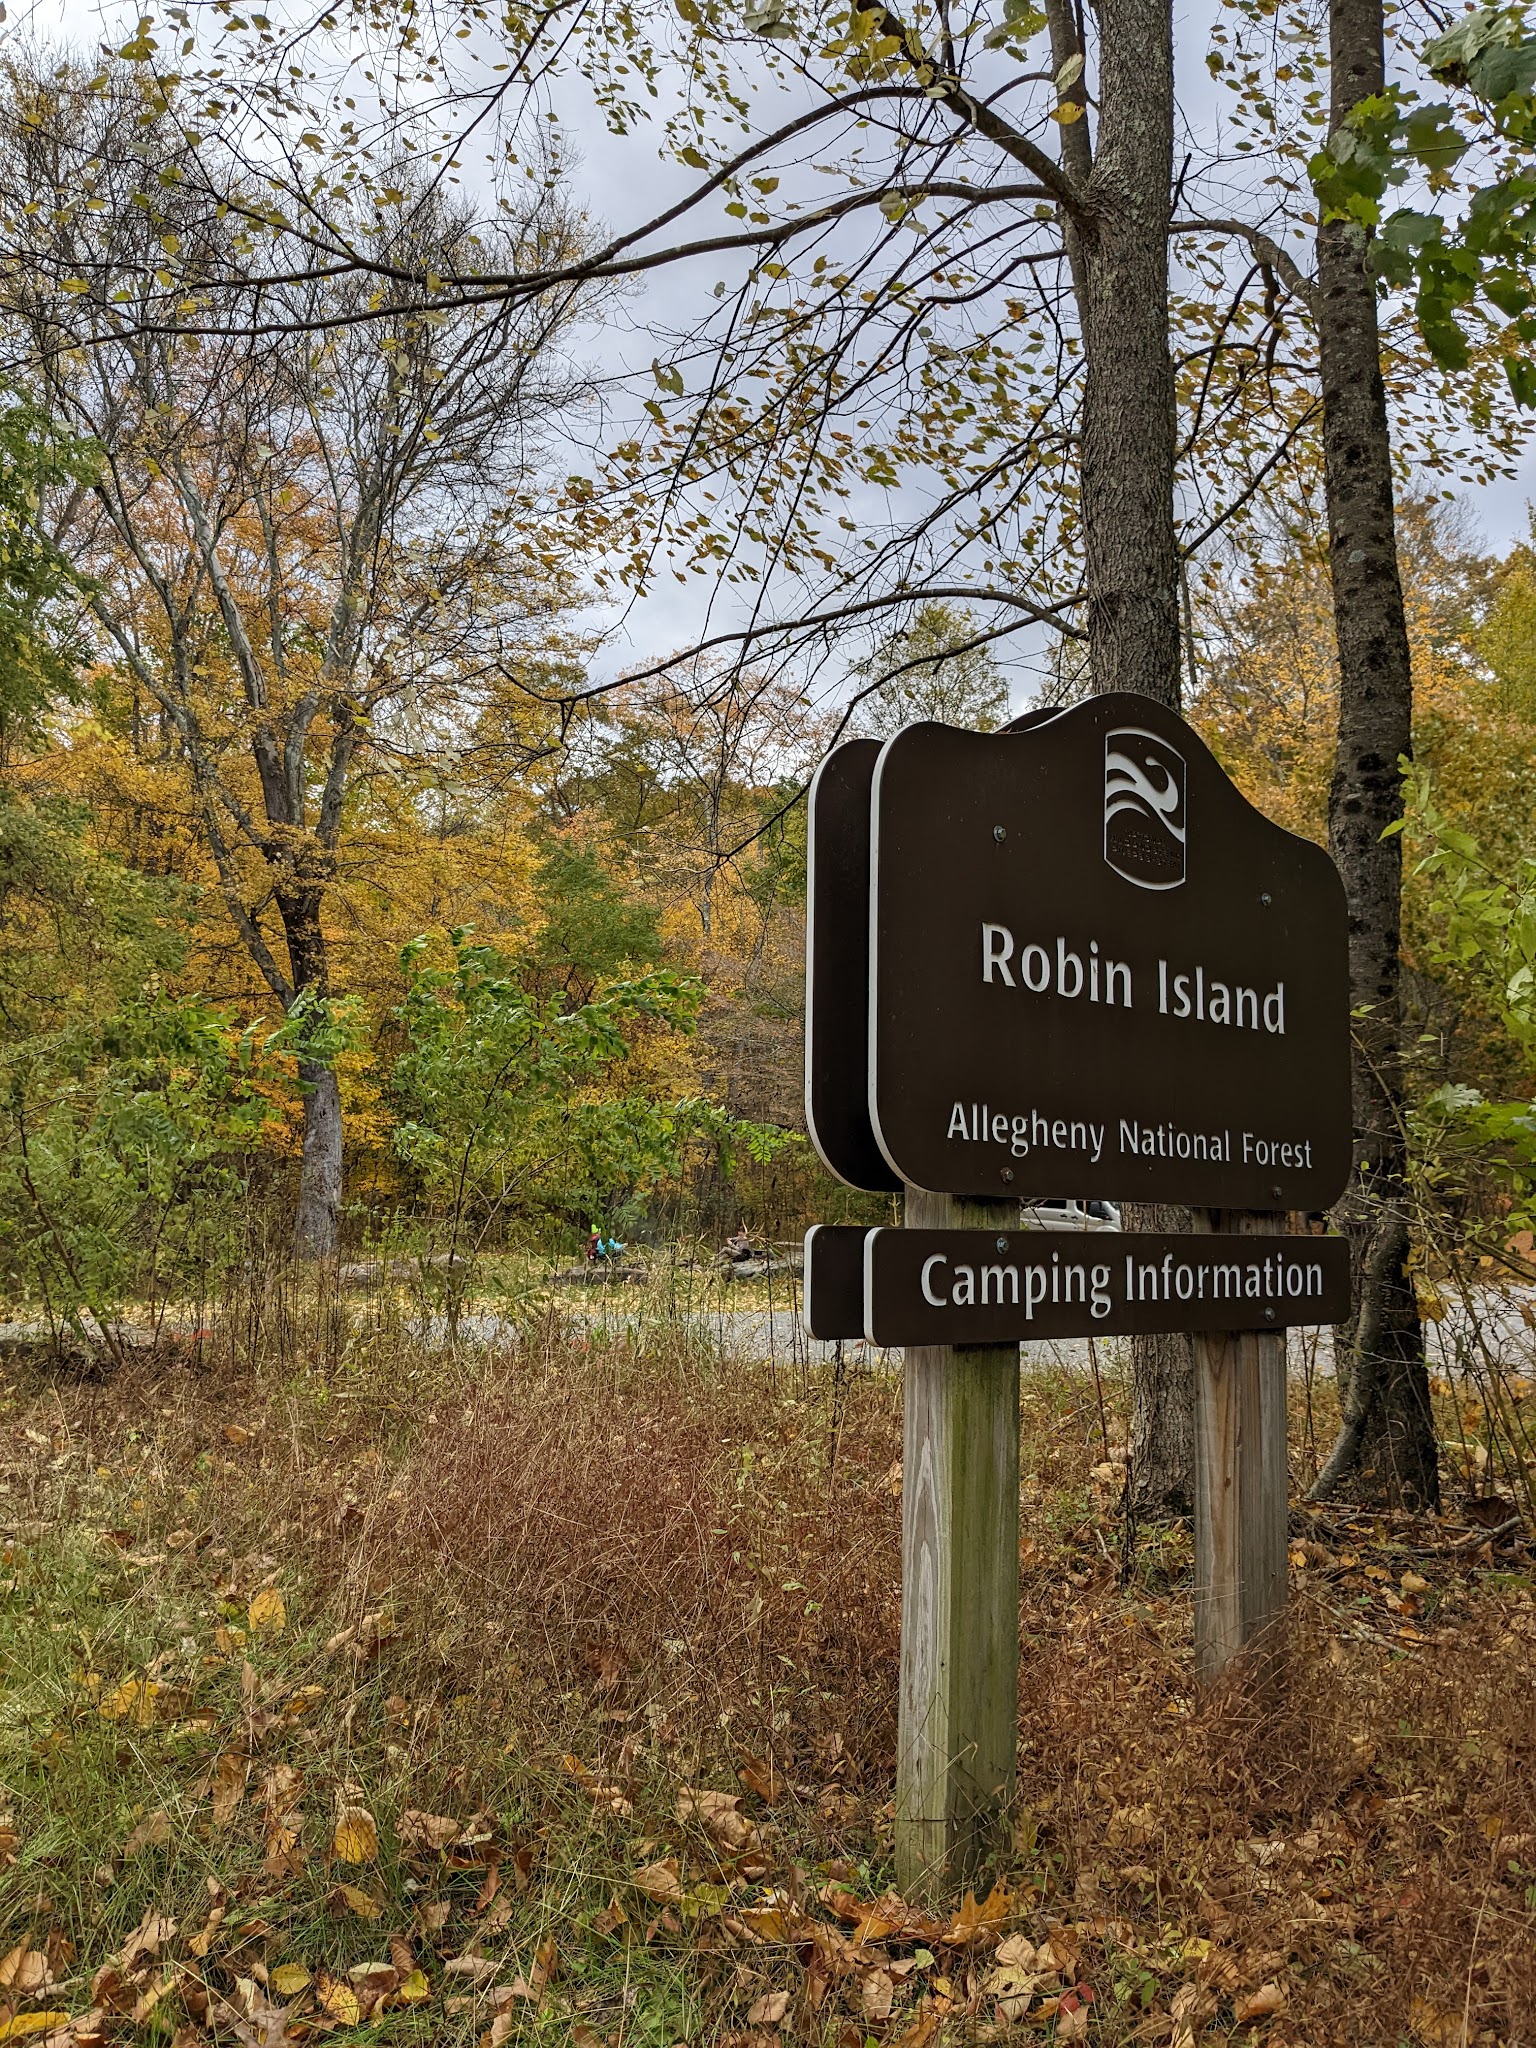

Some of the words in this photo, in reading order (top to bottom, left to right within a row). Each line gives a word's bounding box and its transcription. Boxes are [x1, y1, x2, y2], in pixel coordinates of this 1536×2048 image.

[982, 922, 1133, 1008] Robin
[1158, 959, 1286, 1035] Island
[946, 1102, 1105, 1163] Allegheny
[1119, 1119, 1231, 1162] National
[1242, 1132, 1313, 1169] Forest
[920, 1252, 1112, 1320] Camping
[1126, 1252, 1323, 1301] Information
